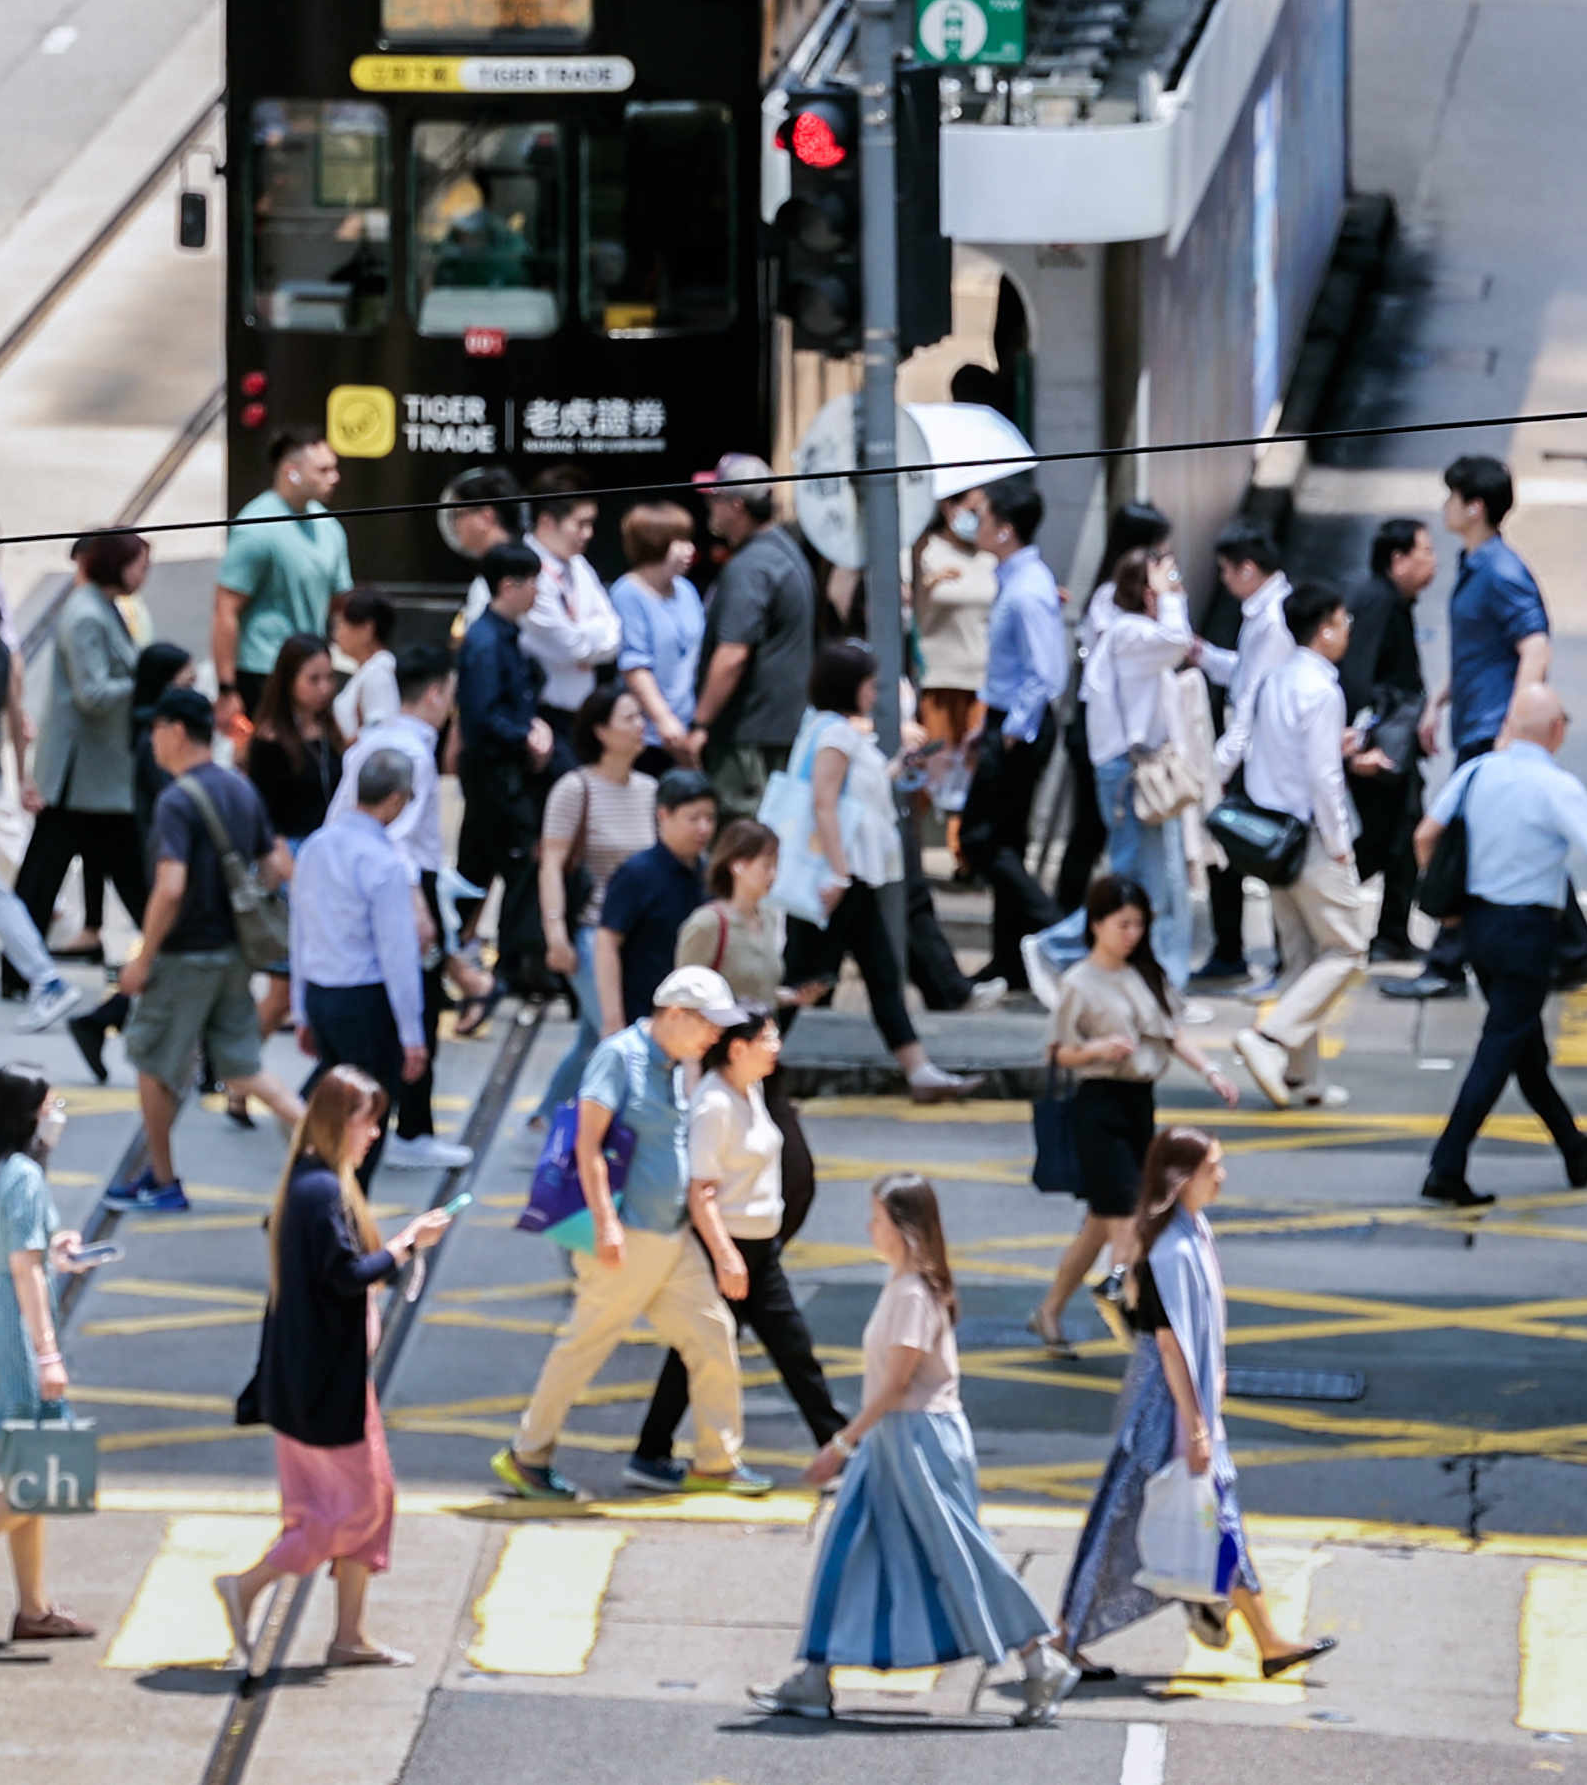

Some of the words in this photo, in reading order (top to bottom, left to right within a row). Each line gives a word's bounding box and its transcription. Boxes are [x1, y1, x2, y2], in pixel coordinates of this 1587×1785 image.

[478, 66, 538, 83] TIGER
[544, 66, 612, 83] TRADE
[401, 394, 486, 423] TIGER
[523, 397, 667, 437] 老虎證券
[401, 423, 496, 454] TRADE
